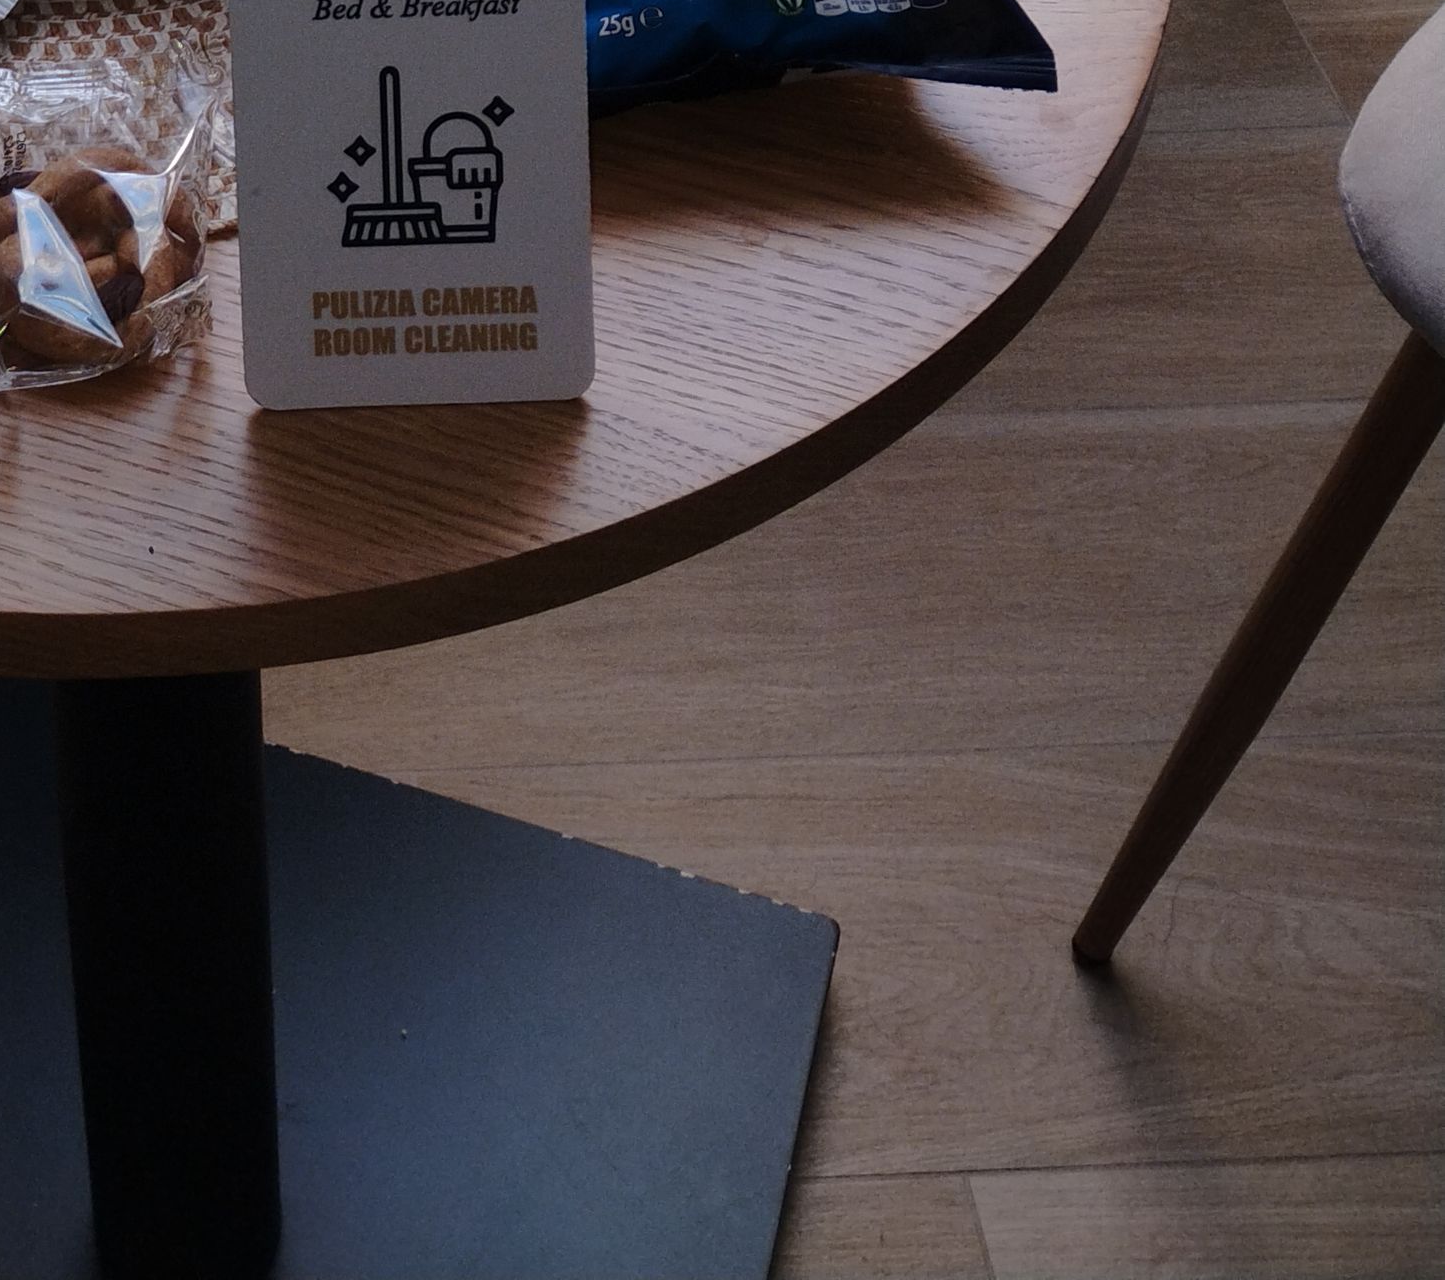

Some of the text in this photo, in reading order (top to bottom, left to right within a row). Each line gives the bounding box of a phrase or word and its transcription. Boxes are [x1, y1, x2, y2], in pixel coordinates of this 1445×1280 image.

[598, 13, 636, 38] 25g
[312, 285, 539, 320] PULIZIA CAMERA
[313, 322, 539, 357] ROOM CLEANING
